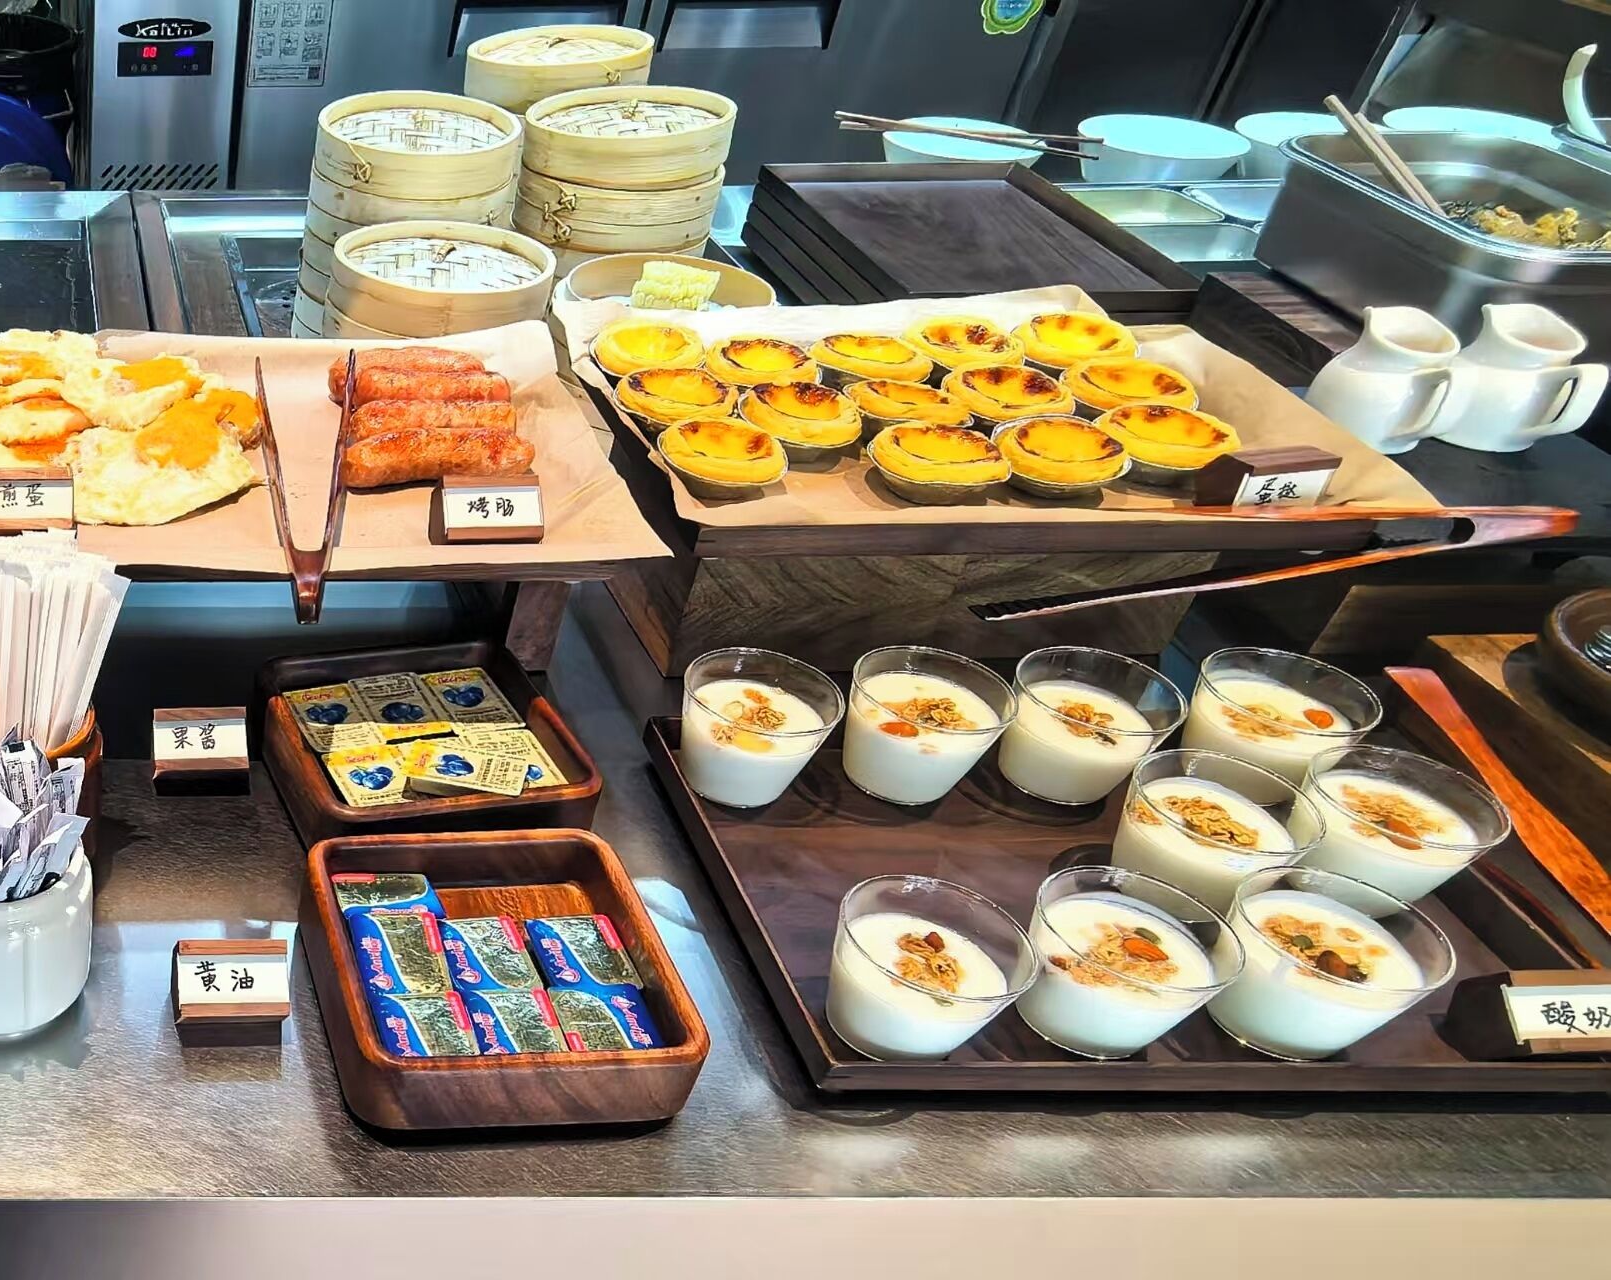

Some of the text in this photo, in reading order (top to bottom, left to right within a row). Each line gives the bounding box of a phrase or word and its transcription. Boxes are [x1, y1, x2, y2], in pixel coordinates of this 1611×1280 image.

[1254, 477, 1301, 505] 蛋挞
[467, 496, 514, 518] 烤肠
[171, 723, 216, 750] 果酱
[194, 961, 254, 992] 黄油
[1541, 1001, 1611, 1035] 酸奶
